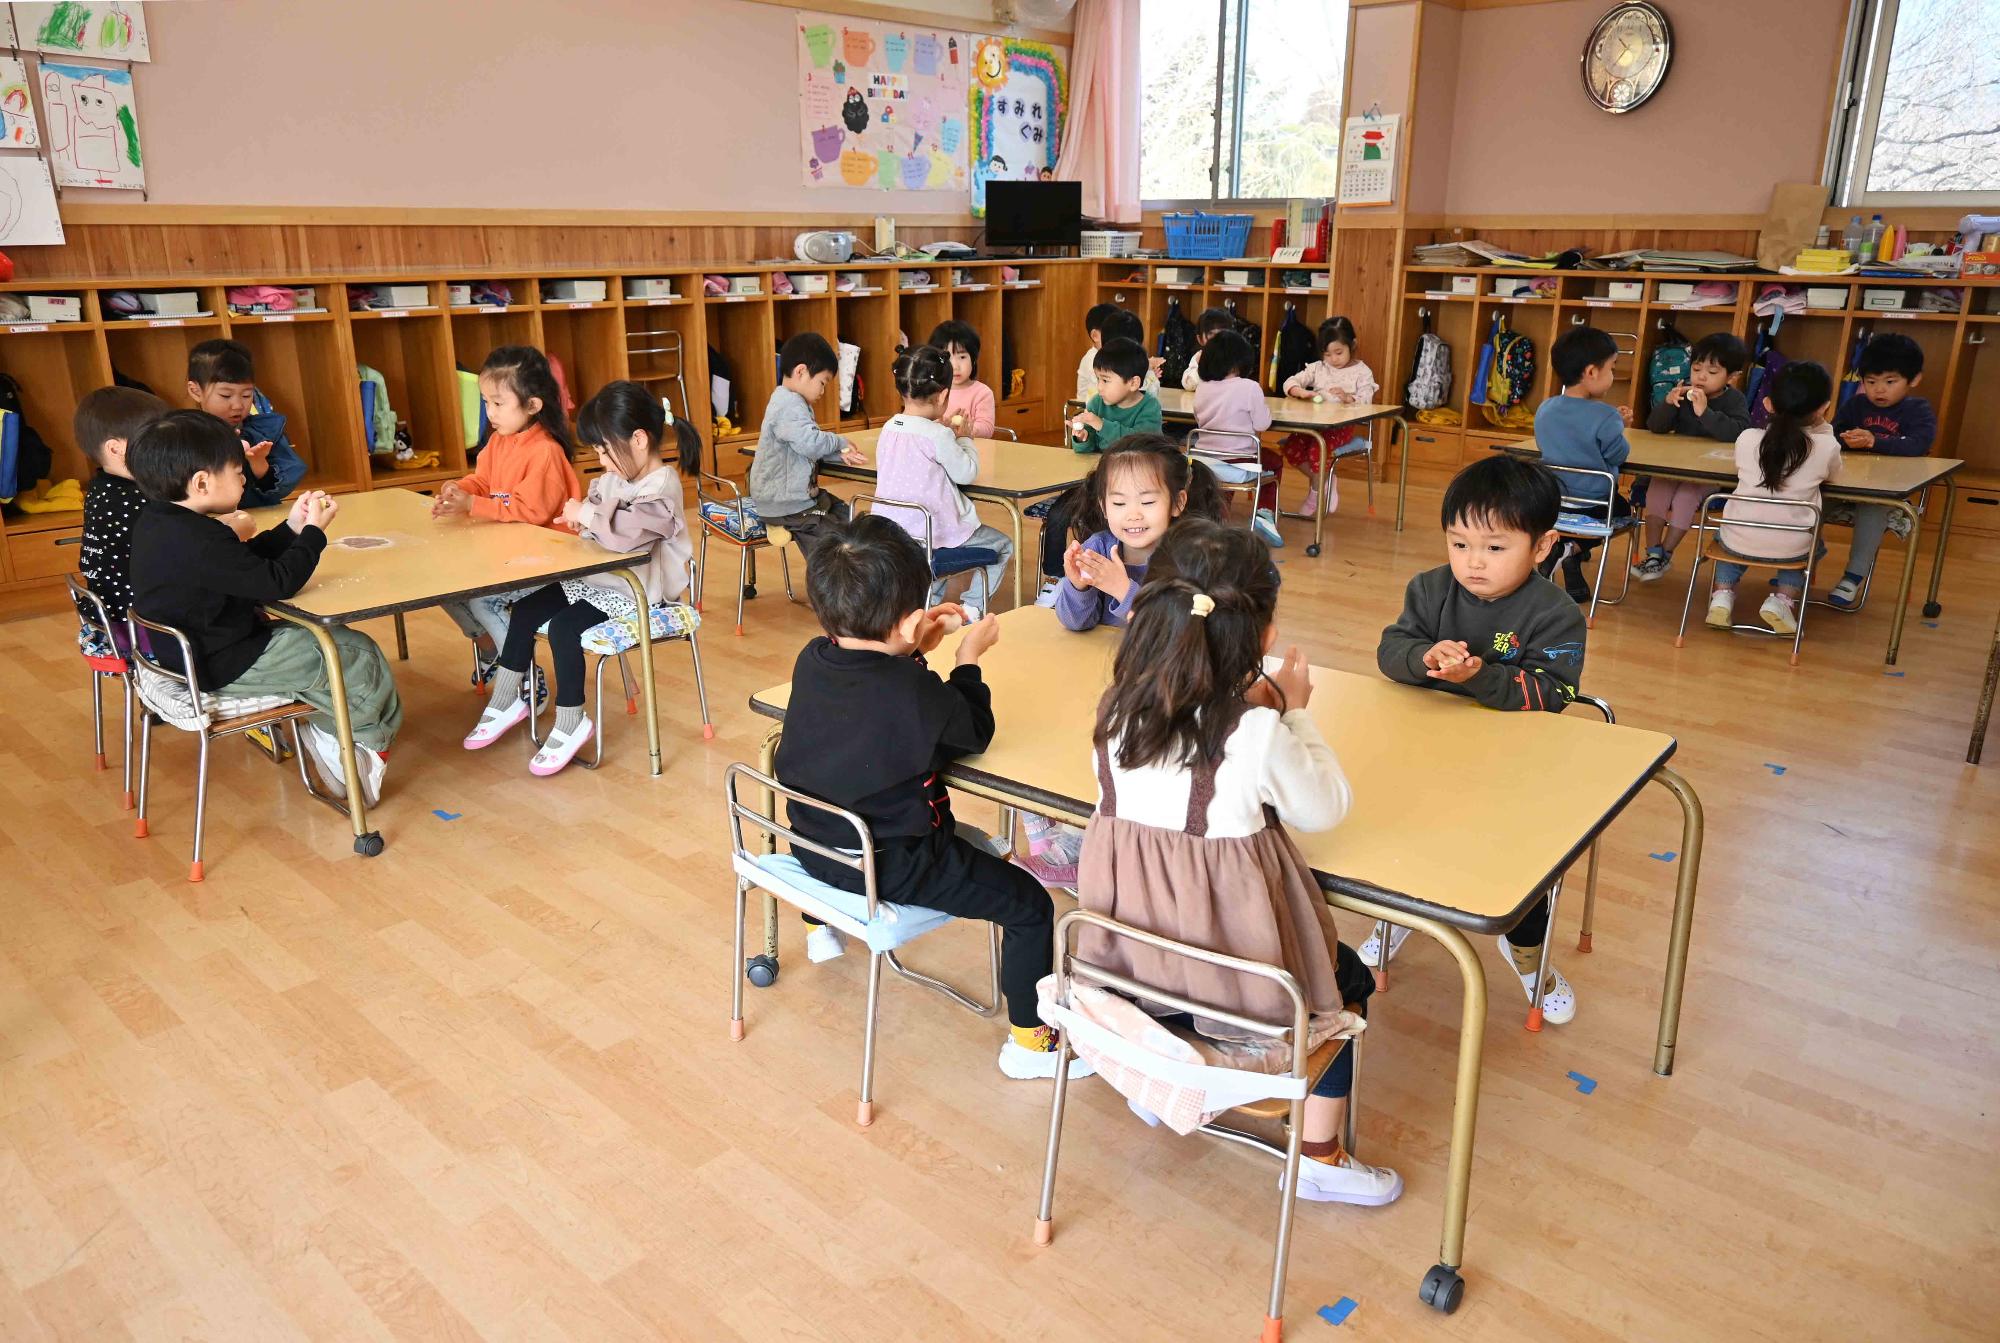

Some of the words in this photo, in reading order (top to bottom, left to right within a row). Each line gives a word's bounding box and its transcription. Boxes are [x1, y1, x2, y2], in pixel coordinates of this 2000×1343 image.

[997, 99, 1042, 119] すみれ
[1020, 124, 1043, 142] ぐみ
